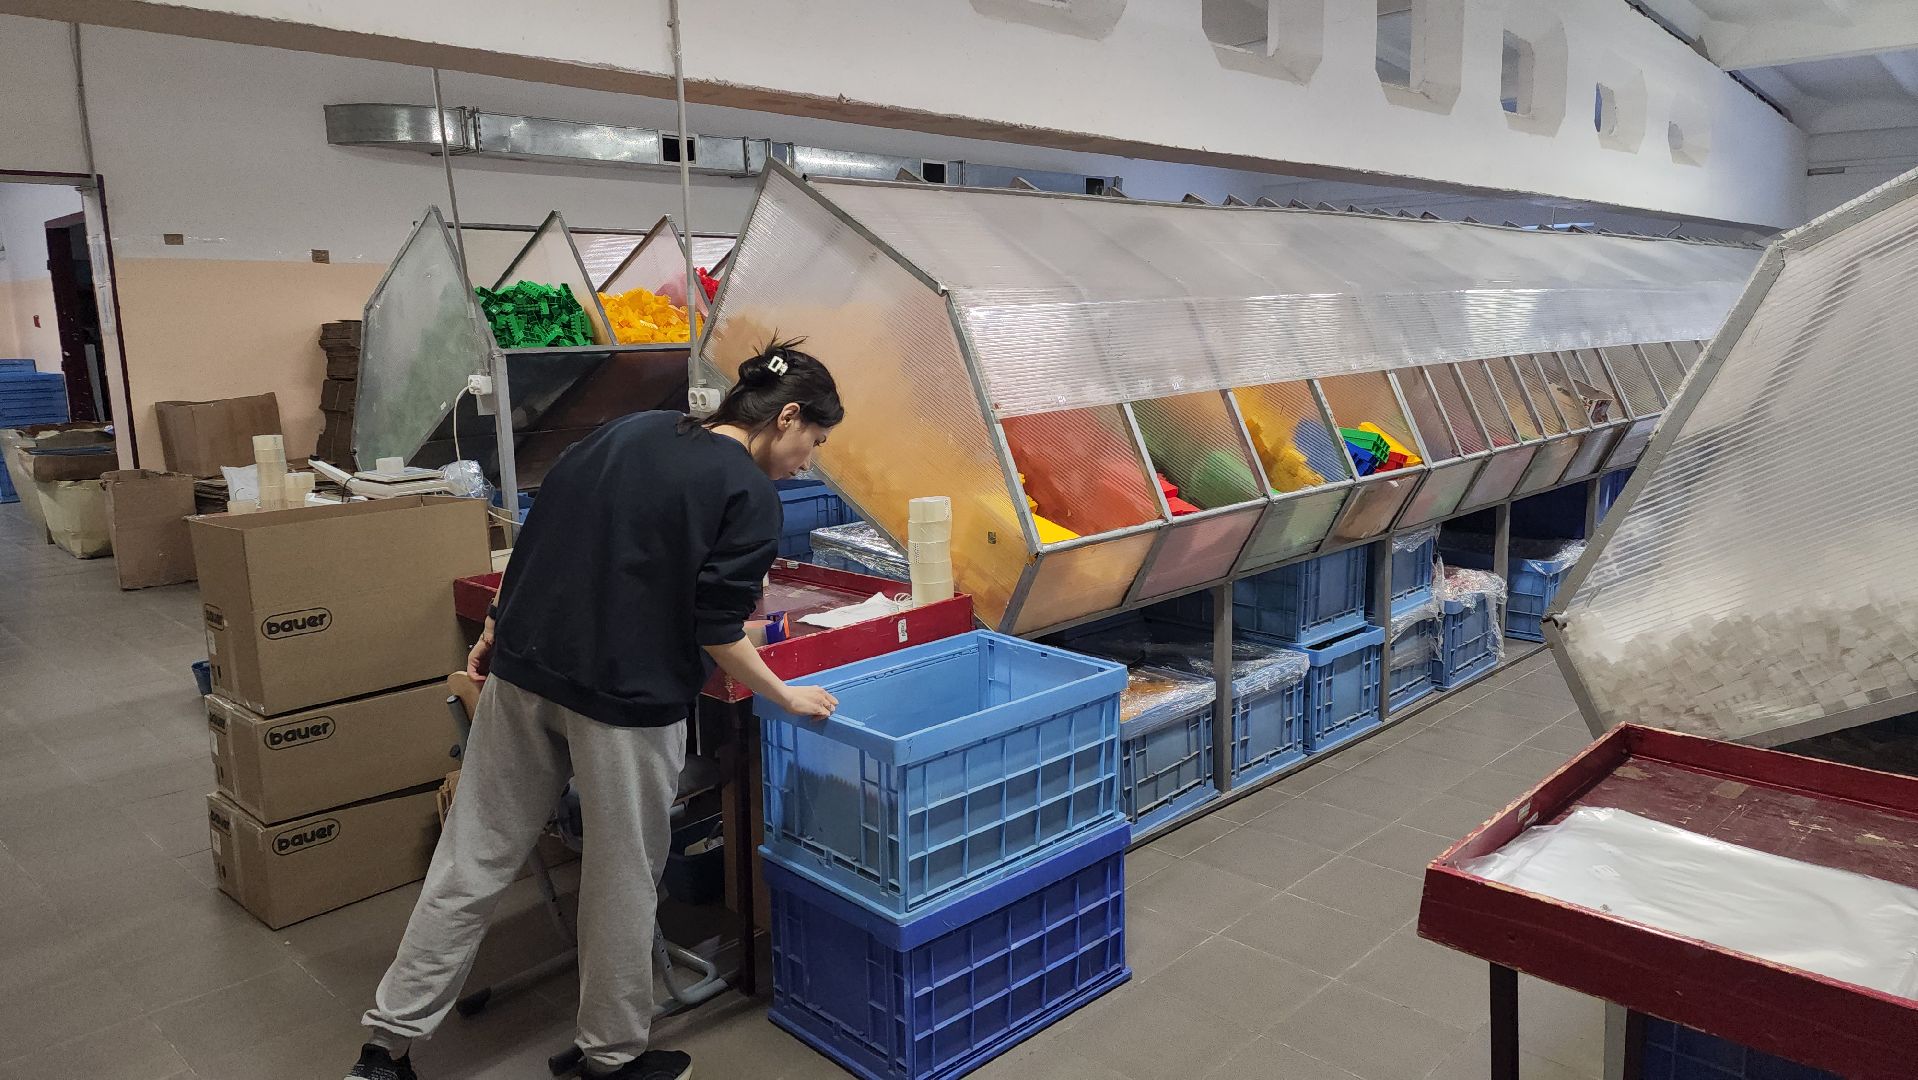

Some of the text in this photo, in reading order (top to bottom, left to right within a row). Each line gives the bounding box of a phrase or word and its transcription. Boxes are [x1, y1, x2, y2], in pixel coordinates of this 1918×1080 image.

[266, 613, 327, 635] bauer
[269, 722, 330, 746] bauer
[277, 823, 336, 852] bauer
